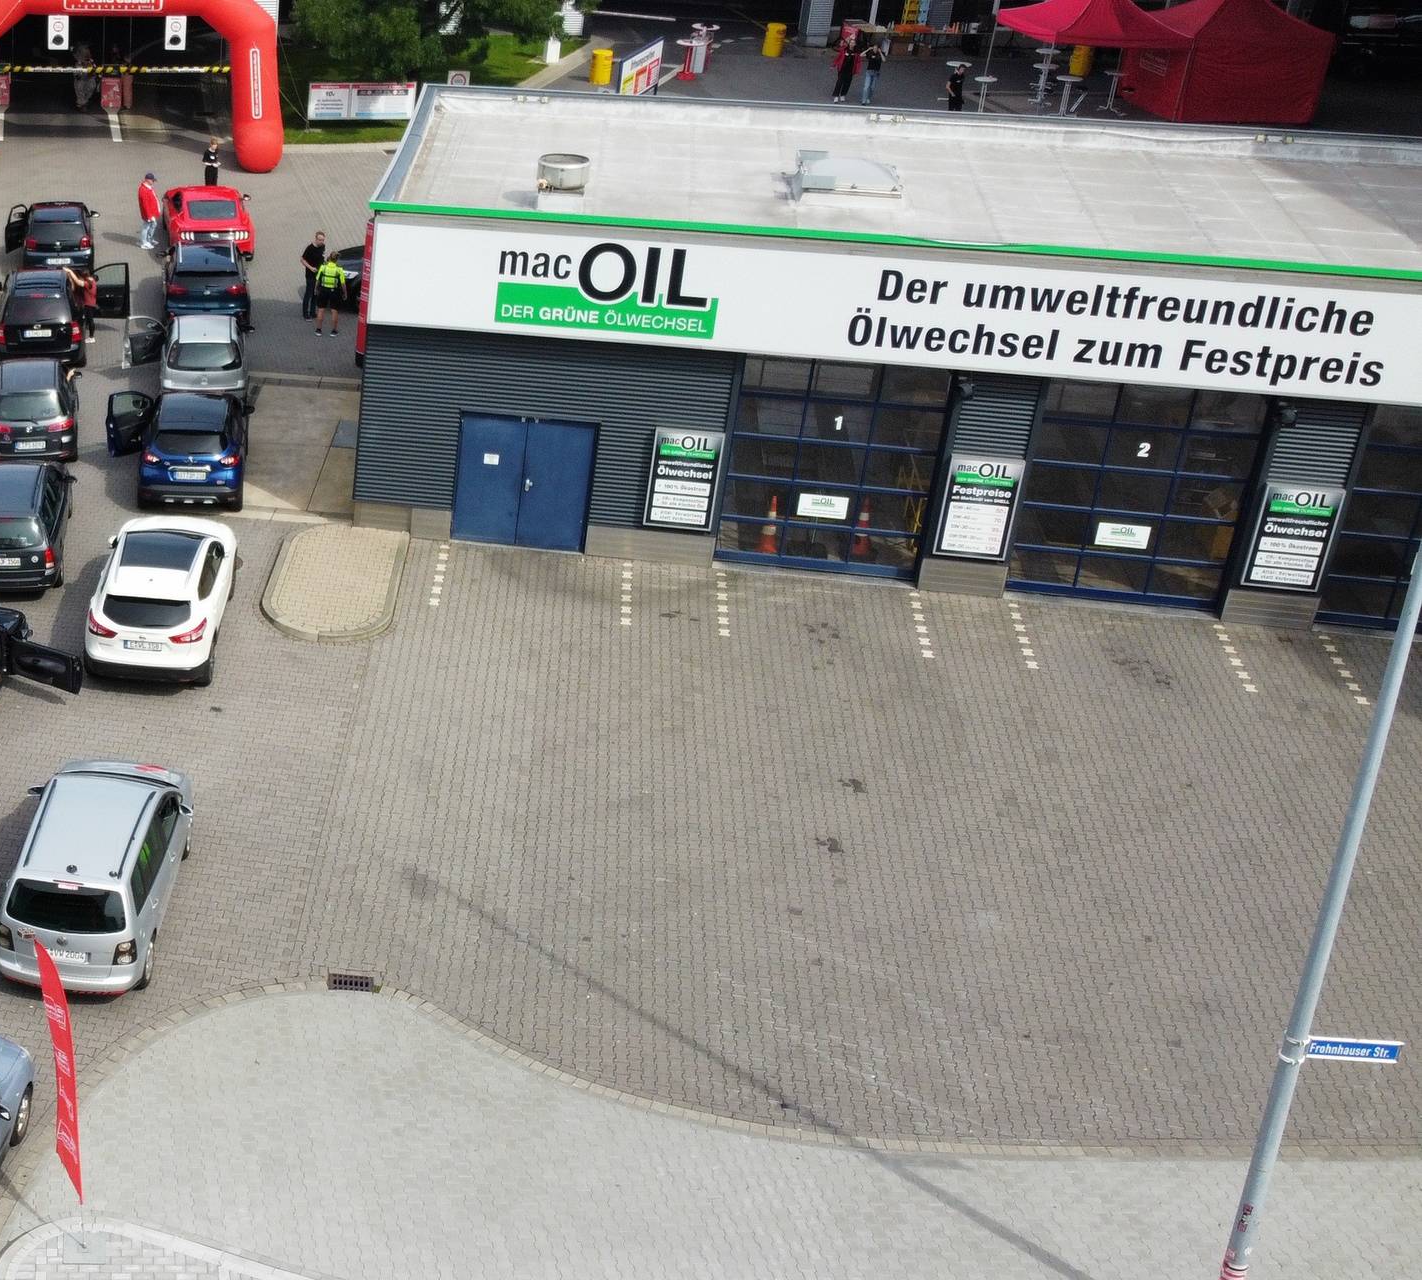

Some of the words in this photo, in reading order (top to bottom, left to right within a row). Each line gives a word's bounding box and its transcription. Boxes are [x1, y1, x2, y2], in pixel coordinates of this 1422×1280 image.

[499, 250, 572, 280] mac
[578, 242, 708, 308] OIL
[877, 269, 948, 305] Der
[963, 281, 1374, 336] umweltfreundliche
[501, 304, 534, 319] DER
[539, 306, 599, 324] GRÜNE
[604, 309, 707, 333] ÖLWECHSEL
[847, 307, 1060, 361] Ölwechsel
[1073, 338, 1163, 369] zum
[1179, 339, 1385, 387] Festpreis
[834, 416, 843, 430] 1
[681, 436, 714, 452] OIL
[1137, 442, 1151, 458] 2
[657, 465, 712, 480] Ölwechsel
[979, 463, 1012, 479] OIL
[952, 485, 1012, 499] Festpreise
[1295, 492, 1330, 508] OIL
[1264, 522, 1327, 538] Ölwechsel
[1309, 1042, 1372, 1057] Frohnhauser
[1373, 1046, 1390, 1058] Str.
